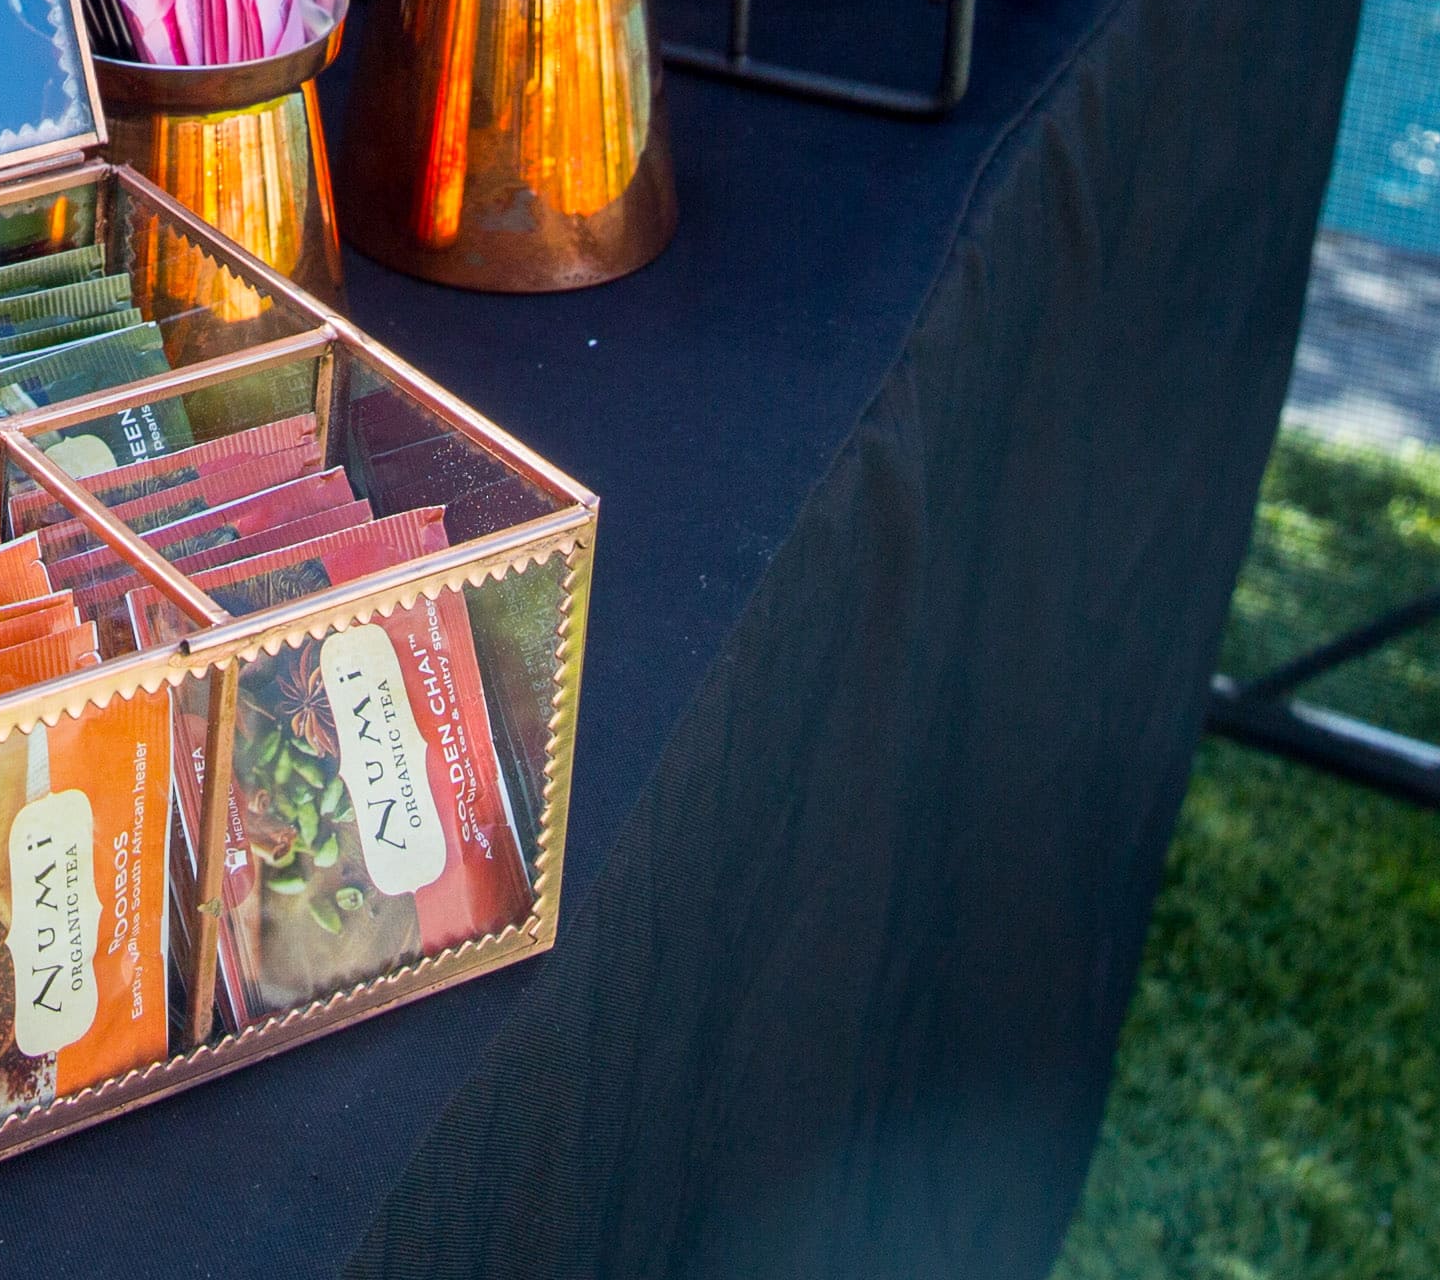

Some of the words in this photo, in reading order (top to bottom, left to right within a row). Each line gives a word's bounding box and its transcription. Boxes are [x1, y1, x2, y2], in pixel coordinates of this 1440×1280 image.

[141, 404, 165, 451] pearls
[376, 677, 397, 724] TEA
[436, 655, 456, 704] sultry
[451, 706, 460, 721] &
[456, 725, 468, 754] tea
[132, 741, 148, 794] healer
[388, 728, 422, 829] ORGANIC
[436, 722, 470, 843] GOLDEN
[464, 756, 477, 804] black
[131, 795, 145, 856] African
[226, 795, 245, 842] MEDIUM
[468, 806, 493, 860] Assam
[64, 842, 79, 889] TEA
[130, 858, 141, 912] South
[107, 830, 128, 956] ROOIBOS
[66, 892, 84, 992] ORGANIC
